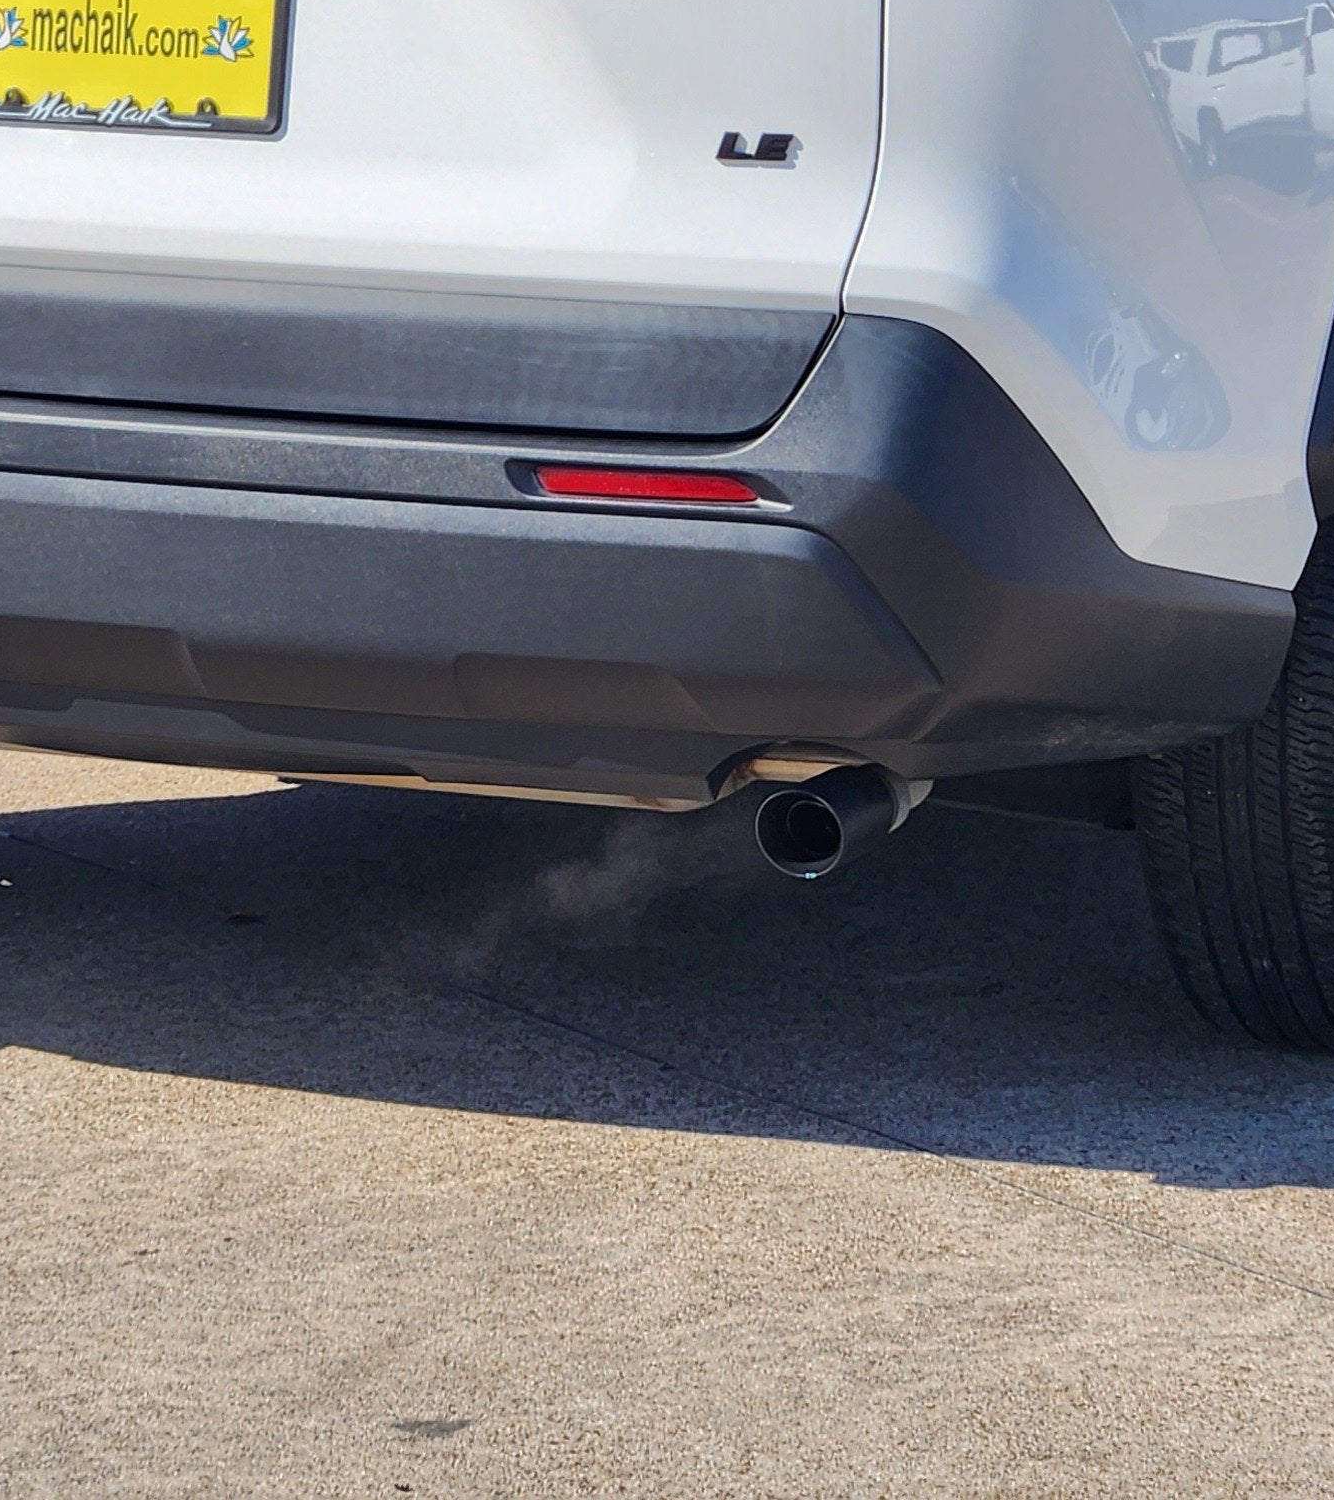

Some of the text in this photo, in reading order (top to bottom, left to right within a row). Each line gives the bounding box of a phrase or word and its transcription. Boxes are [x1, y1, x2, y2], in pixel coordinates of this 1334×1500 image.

[25, 90, 205, 128] Mac Haik
[716, 131, 798, 163] LE
